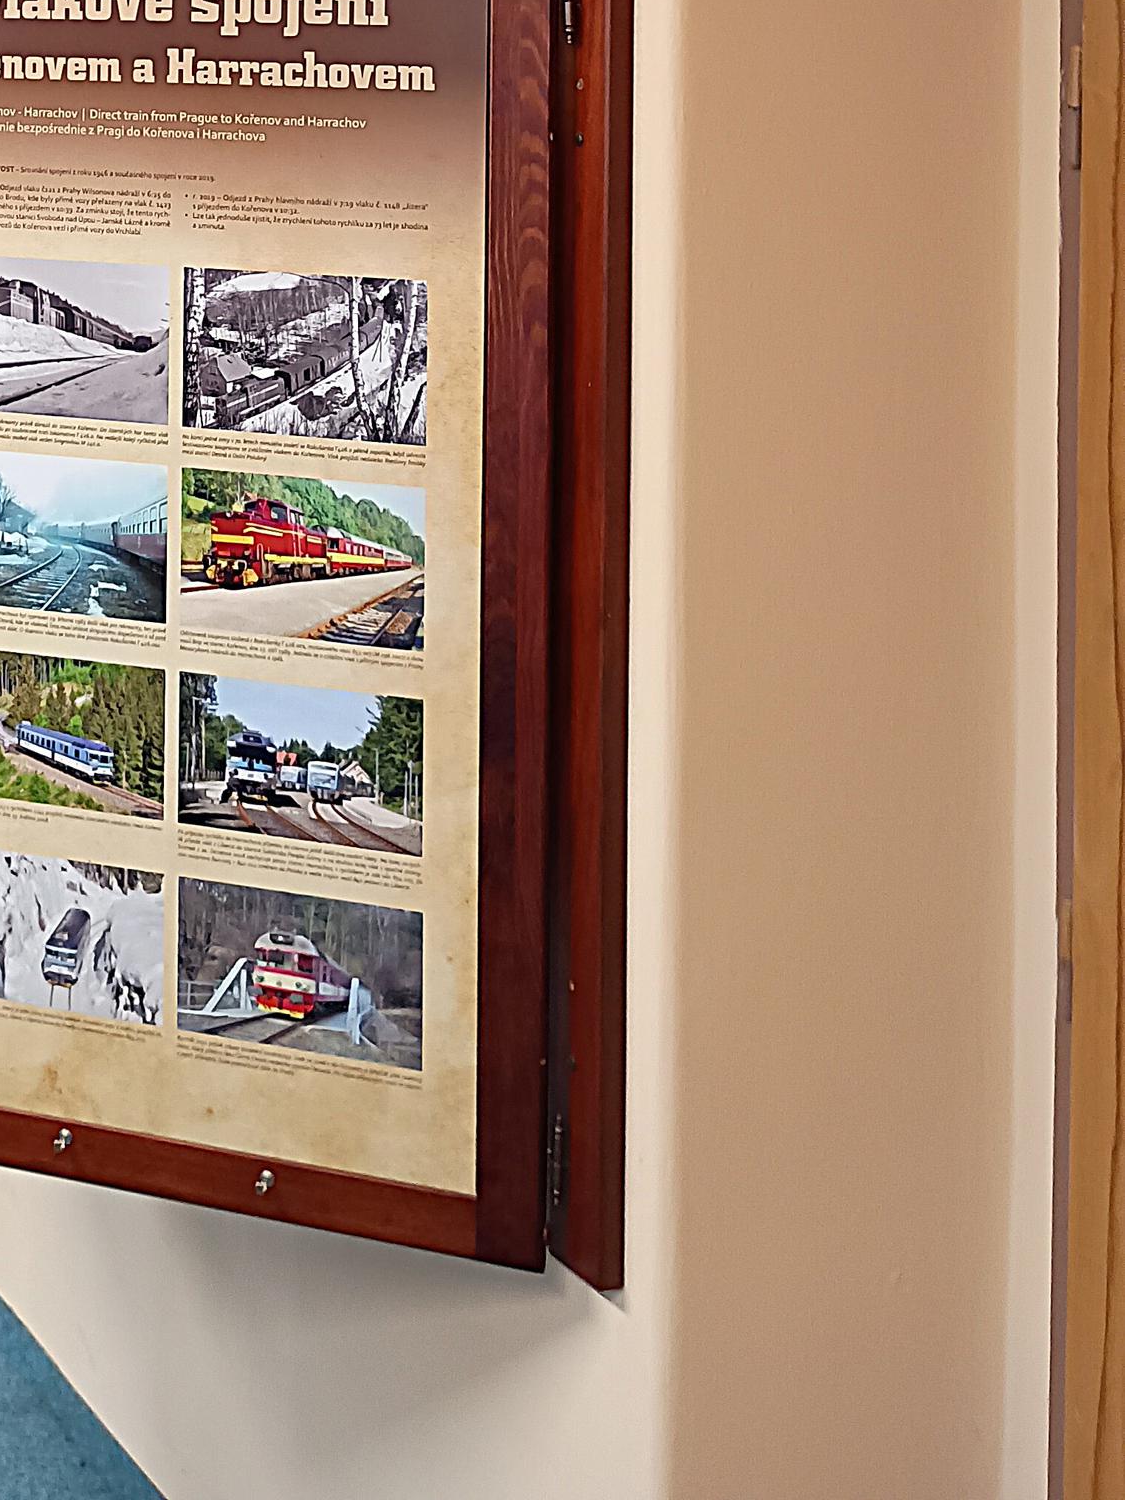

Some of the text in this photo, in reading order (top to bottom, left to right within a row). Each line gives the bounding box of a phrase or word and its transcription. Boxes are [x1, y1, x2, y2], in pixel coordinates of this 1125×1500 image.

[133, 59, 154, 82] a
[167, 49, 435, 90] Harrachovem
[23, 106, 78, 120] Harrachov
[89, 108, 123, 121] Direct
[121, 109, 149, 122] train
[149, 110, 178, 123] from
[179, 111, 219, 126] Prague
[219, 112, 233, 125] to
[233, 113, 281, 126] Kořenov
[283, 114, 304, 127] and
[307, 115, 366, 129] Harrachov
[16, 122, 87, 138] bezpośrednie
[86, 127, 95, 137] z
[96, 125, 125, 139] Pragi
[125, 126, 142, 138] do
[141, 126, 195, 140] Kořenova
[195, 128, 201, 140] i
[202, 128, 267, 143] Harrachova
